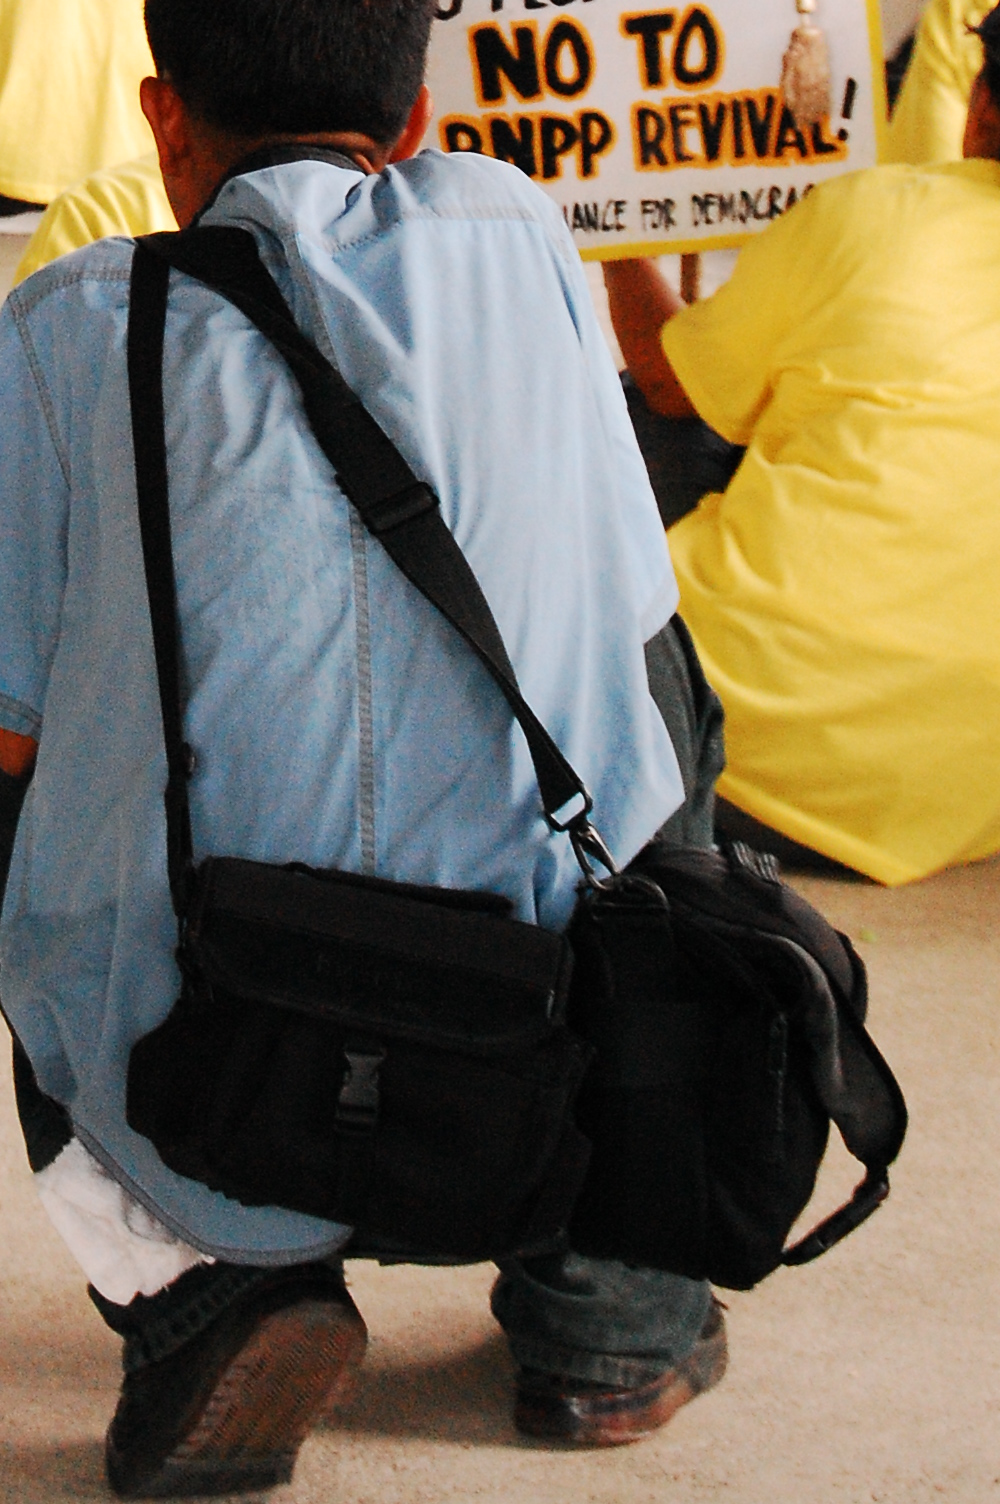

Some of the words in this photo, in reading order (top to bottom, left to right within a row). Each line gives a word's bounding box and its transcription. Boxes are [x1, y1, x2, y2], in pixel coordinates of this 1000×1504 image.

[469, 15, 595, 105] NO
[622, 4, 725, 91] TO
[631, 78, 857, 172] REVIVAL!
